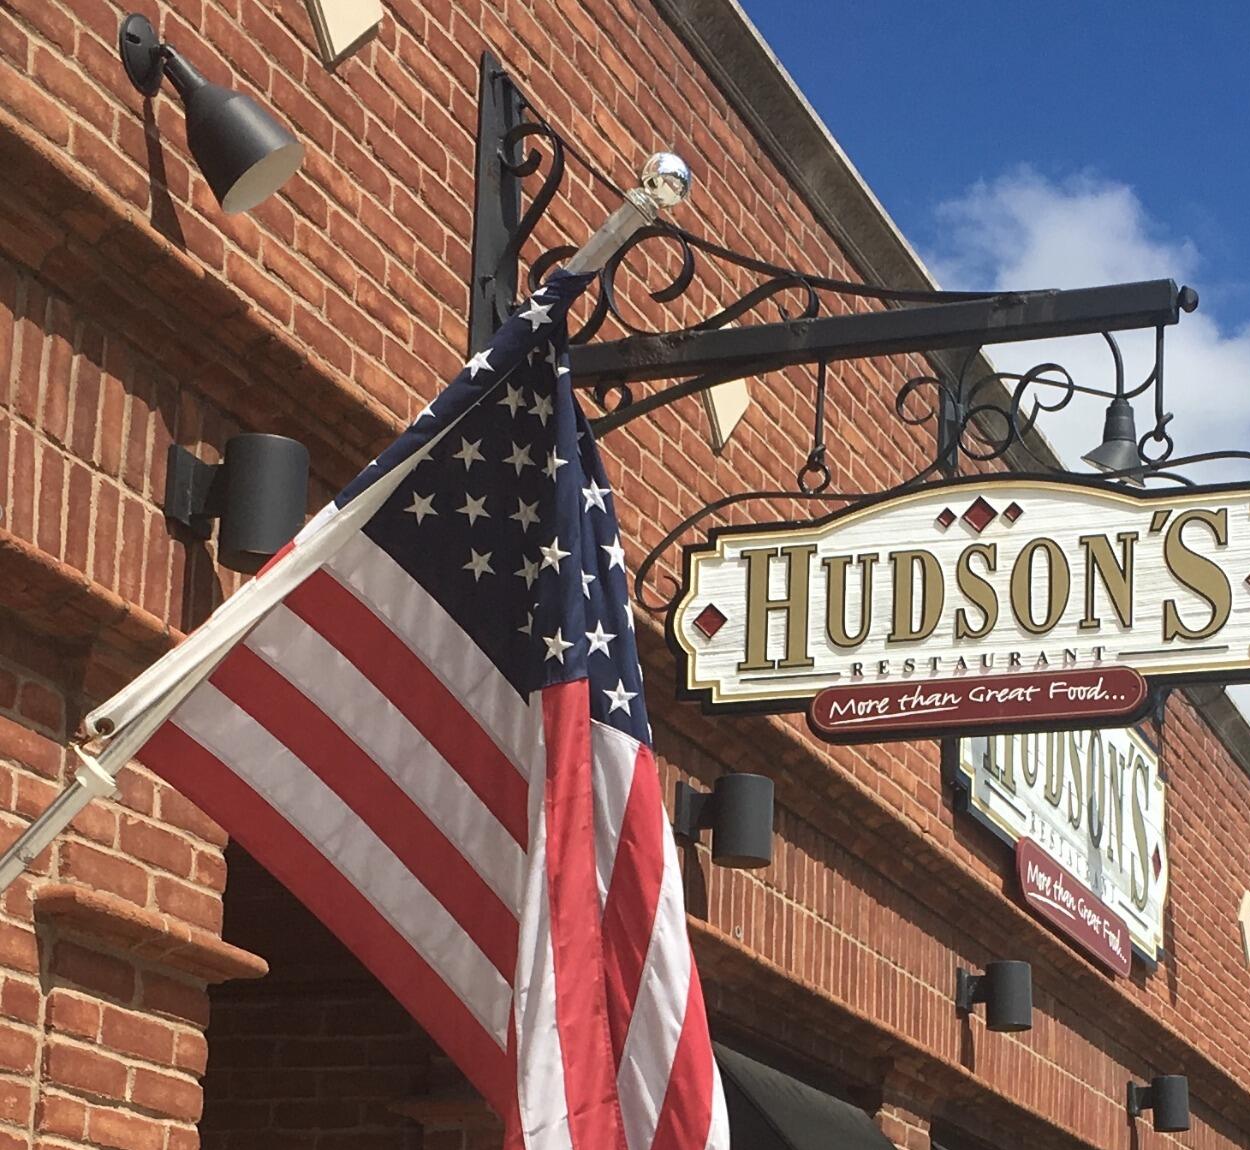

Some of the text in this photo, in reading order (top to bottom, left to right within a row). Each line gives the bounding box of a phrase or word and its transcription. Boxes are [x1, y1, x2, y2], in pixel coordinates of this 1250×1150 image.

[737, 508, 1232, 671] HUDSON'S
[852, 646, 1106, 677] RESTAURANT
[829, 694, 889, 718] More
[897, 684, 962, 708] than
[969, 685, 1040, 702] Great
